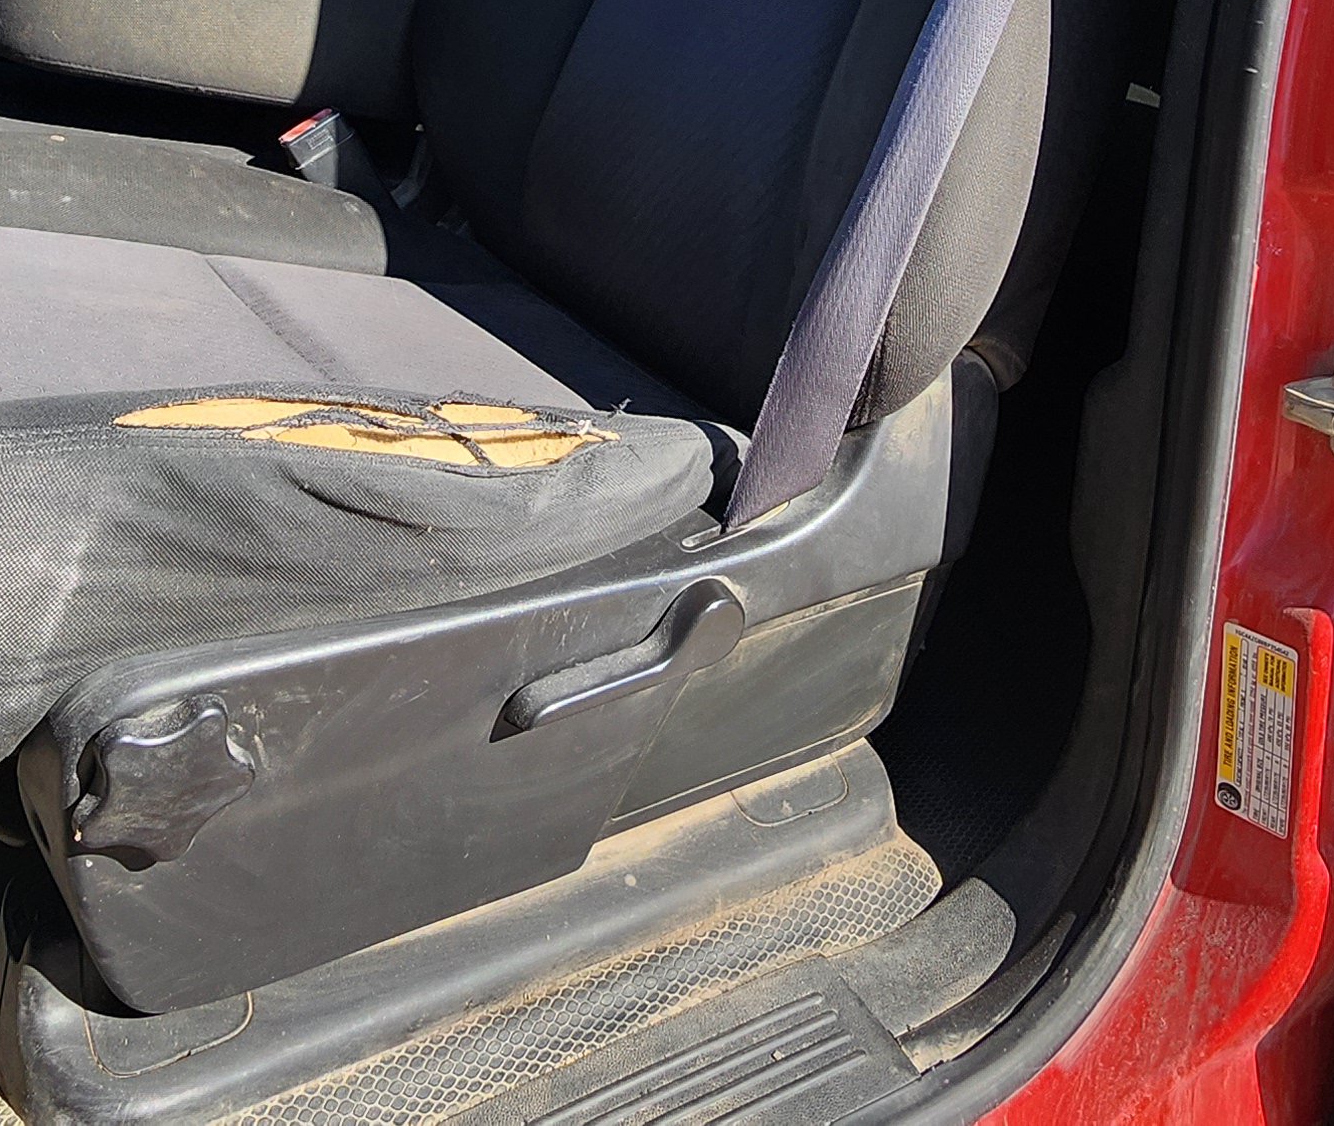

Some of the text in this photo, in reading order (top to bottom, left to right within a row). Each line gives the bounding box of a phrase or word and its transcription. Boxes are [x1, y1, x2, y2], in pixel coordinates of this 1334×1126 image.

[1223, 645, 1238, 767] TIRE AND LOADING INFORMATION
